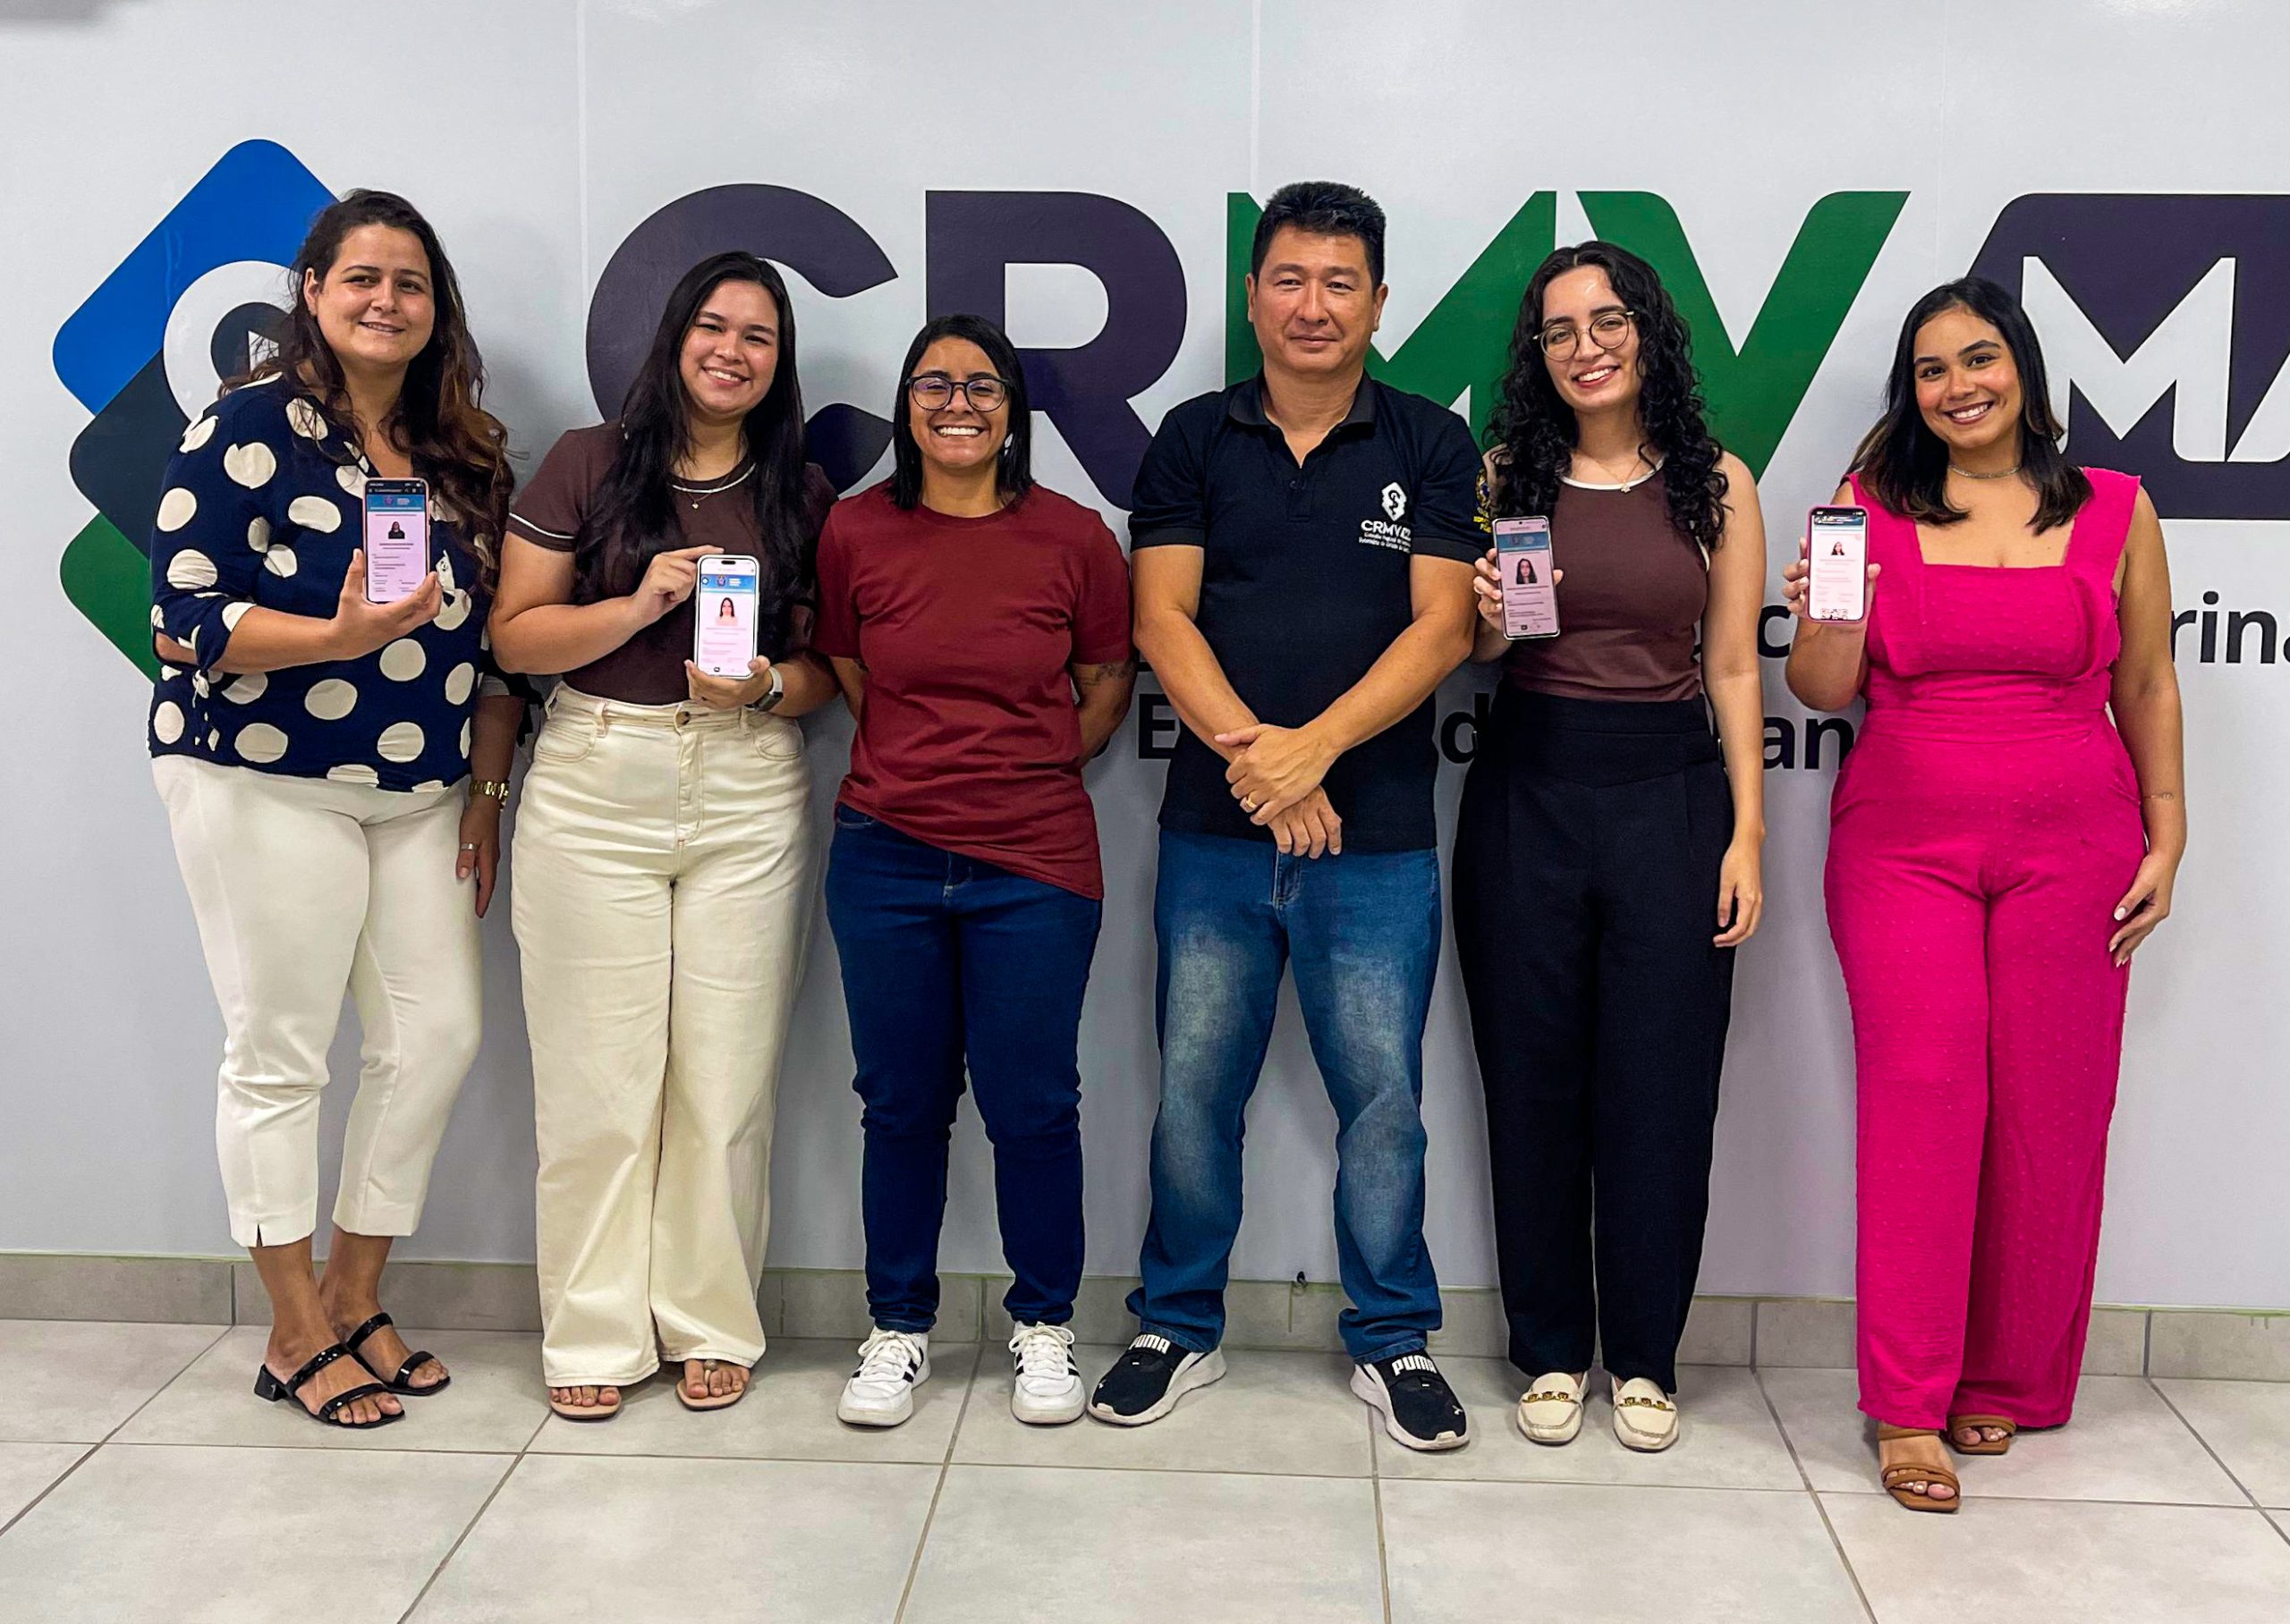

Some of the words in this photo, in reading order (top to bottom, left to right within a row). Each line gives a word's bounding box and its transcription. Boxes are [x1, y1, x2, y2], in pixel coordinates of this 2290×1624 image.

[2022, 256, 2290, 462] M
[1361, 520, 1402, 537] CRMV
[1128, 1334, 1171, 1355] PUMA
[1392, 1355, 1437, 1376] PUMA
